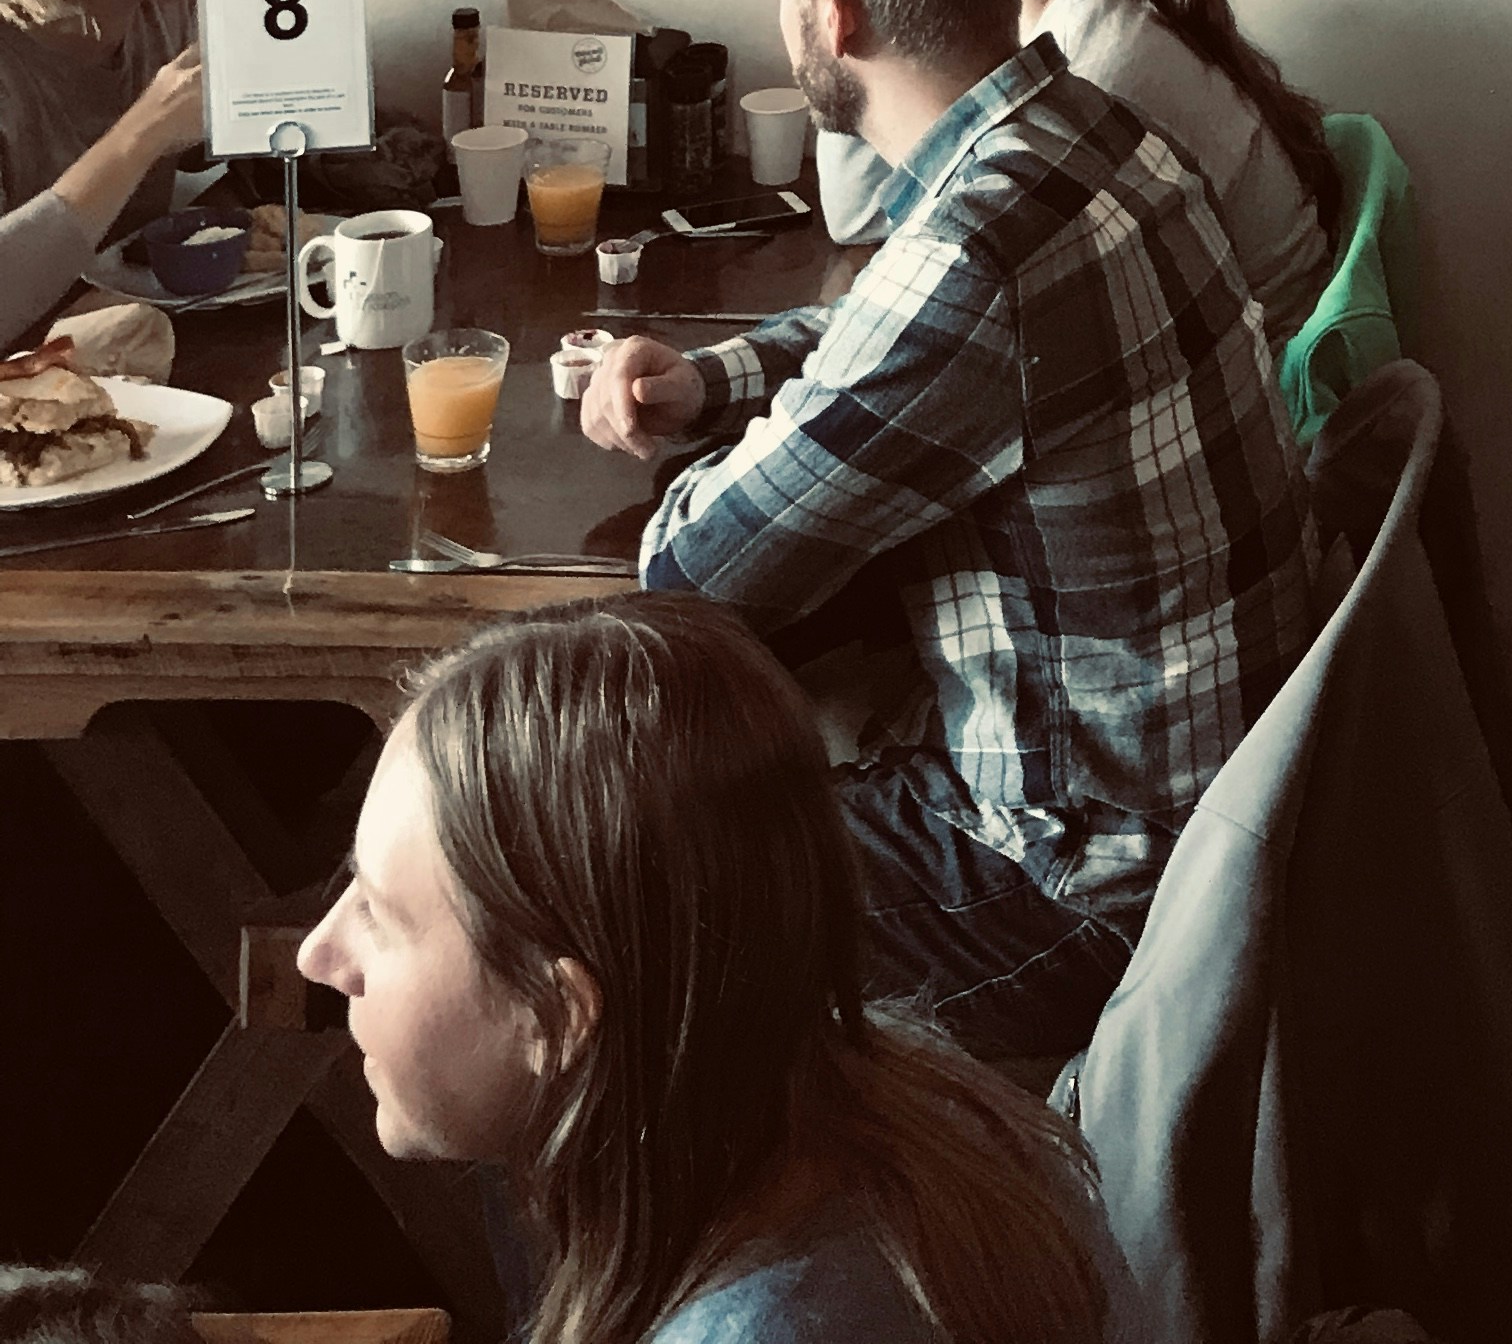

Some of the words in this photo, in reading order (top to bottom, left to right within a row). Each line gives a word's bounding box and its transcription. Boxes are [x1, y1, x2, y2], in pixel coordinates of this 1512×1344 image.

[503, 81, 609, 103] RESERVED
[518, 104, 536, 113] FOR
[538, 106, 594, 118] CUSTOMERS
[539, 122, 565, 132] TABLE
[568, 124, 608, 134] NUMBER
